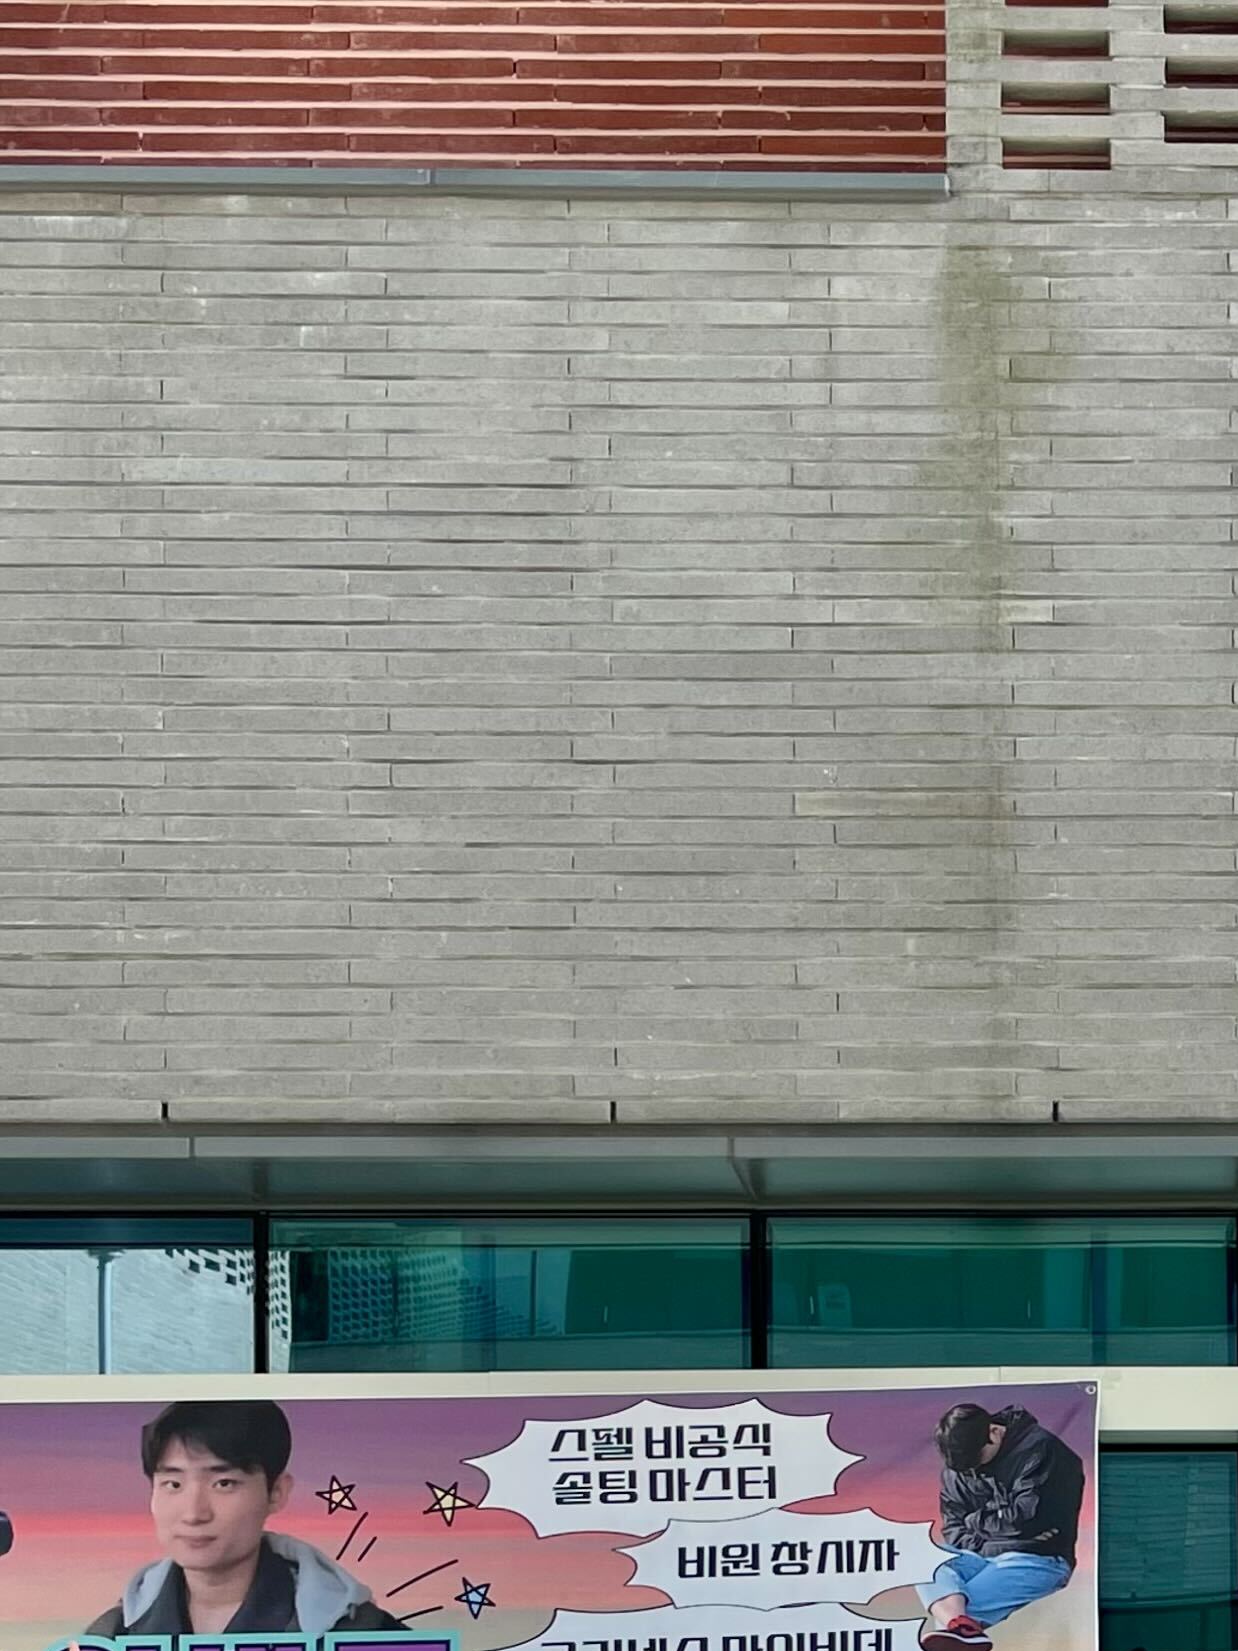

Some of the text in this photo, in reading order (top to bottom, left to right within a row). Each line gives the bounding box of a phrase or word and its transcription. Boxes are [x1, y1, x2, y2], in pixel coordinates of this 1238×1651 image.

[548, 1423, 772, 1462] 스펠 비공식
[553, 1465, 777, 1505] 솔팅 마스터
[677, 1539, 900, 1578] 비원 창시자
